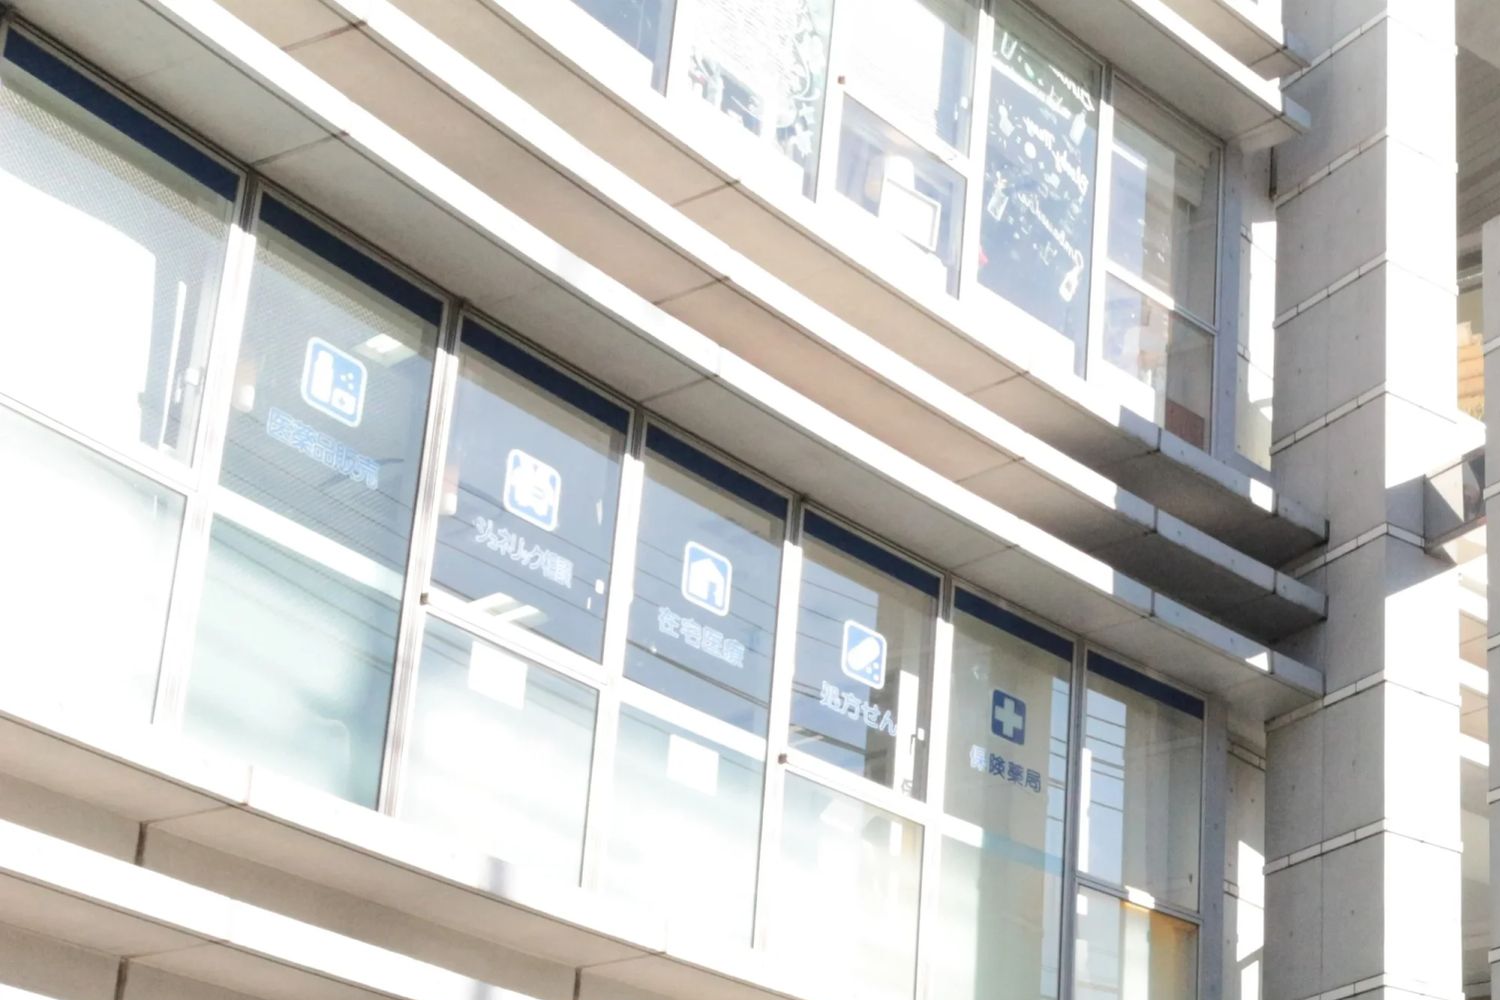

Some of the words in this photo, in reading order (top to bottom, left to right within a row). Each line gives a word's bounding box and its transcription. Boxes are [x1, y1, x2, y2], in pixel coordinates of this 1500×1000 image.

[266, 406, 380, 490] 医薬品販売
[657, 605, 745, 669] 在宅医療
[819, 680, 898, 738] 処方せん
[968, 743, 1042, 794] 保険薬局
